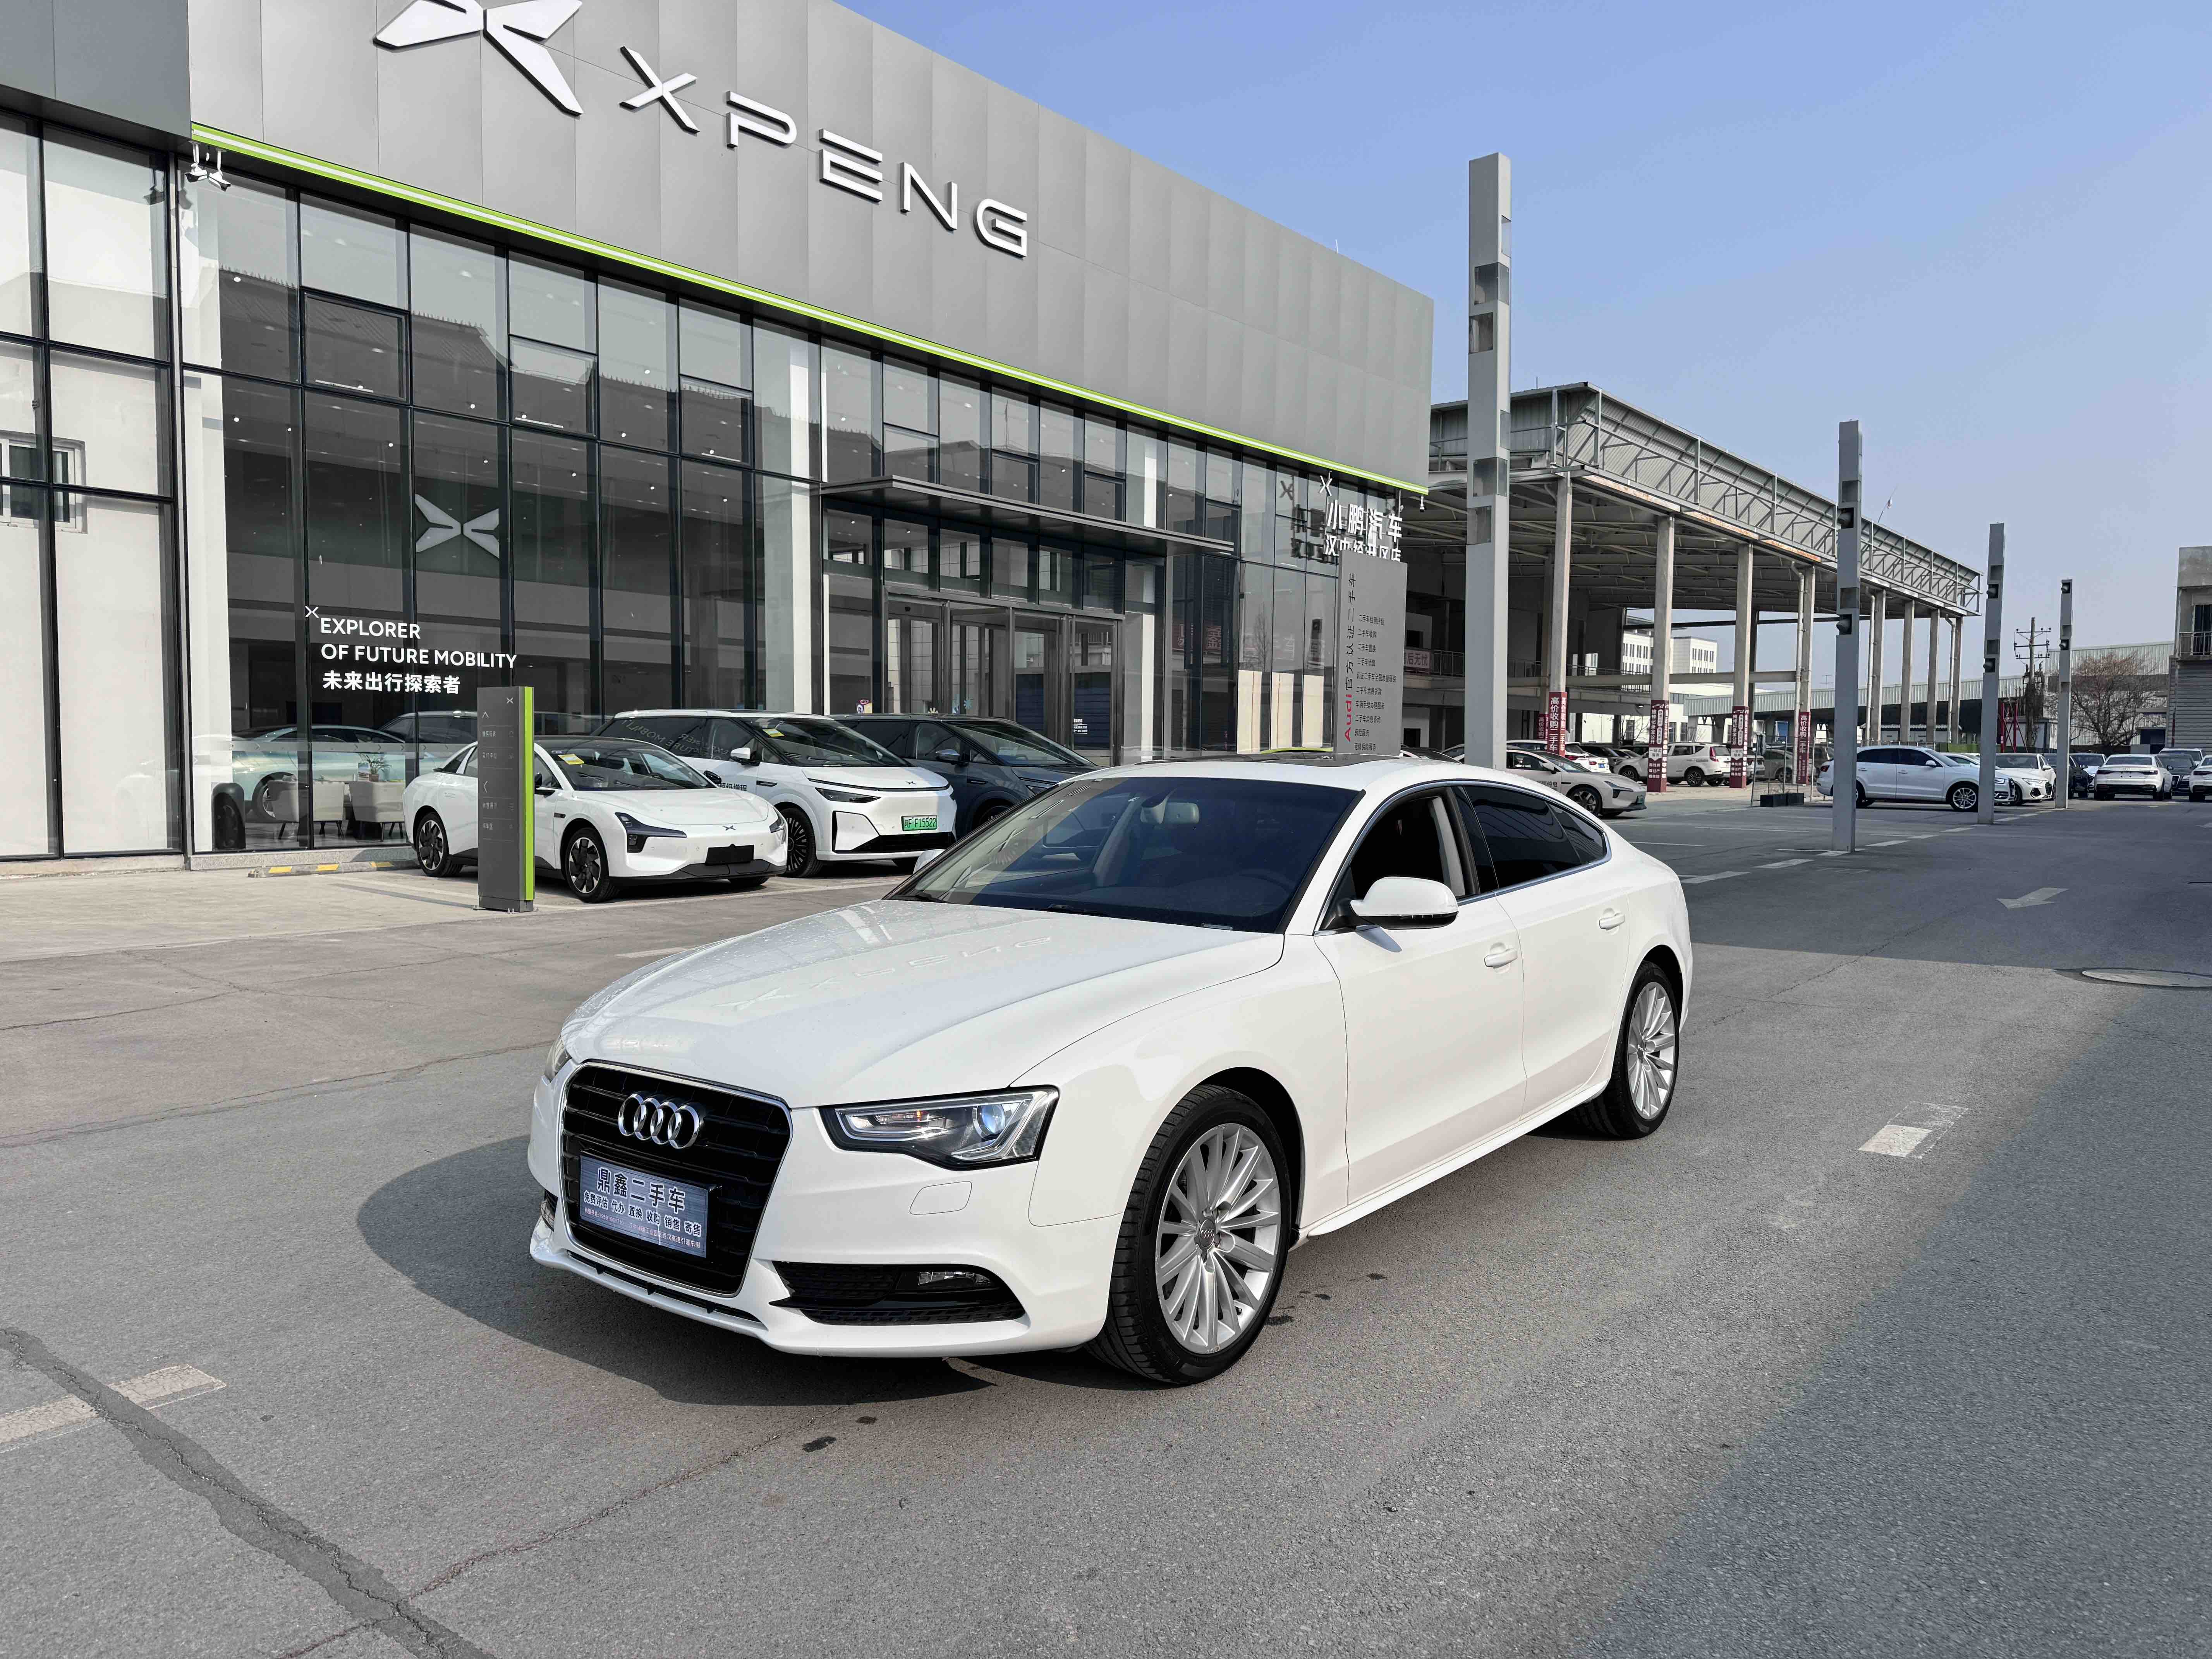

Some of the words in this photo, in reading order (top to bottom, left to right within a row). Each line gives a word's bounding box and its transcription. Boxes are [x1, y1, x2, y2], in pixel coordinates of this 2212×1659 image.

[620, 46, 1027, 258] XPENG
[1327, 499, 1402, 543] 小鹏汽车
[321, 618, 421, 639] EXPLORER
[1345, 573, 1355, 690] 官方认证二手车
[1358, 629, 1377, 638] 二手车收购
[1358, 644, 1376, 652] 二手车置换
[321, 643, 349, 660] OF
[355, 646, 429, 664] FUTURE
[434, 651, 517, 668] MOBILITY
[323, 670, 460, 694] 未来出行探索者
[1549, 697, 1559, 752] 高价收购二手车
[598, 1167, 685, 1214] 鼎鑫二手车
[584, 1190, 608, 1210] 免费评估
[611, 1199, 625, 1214] 代办
[628, 1204, 643, 1220] 置换
[646, 1210, 661, 1225] 收购
[664, 1214, 680, 1231] 销售
[684, 1220, 701, 1237] 寄售
